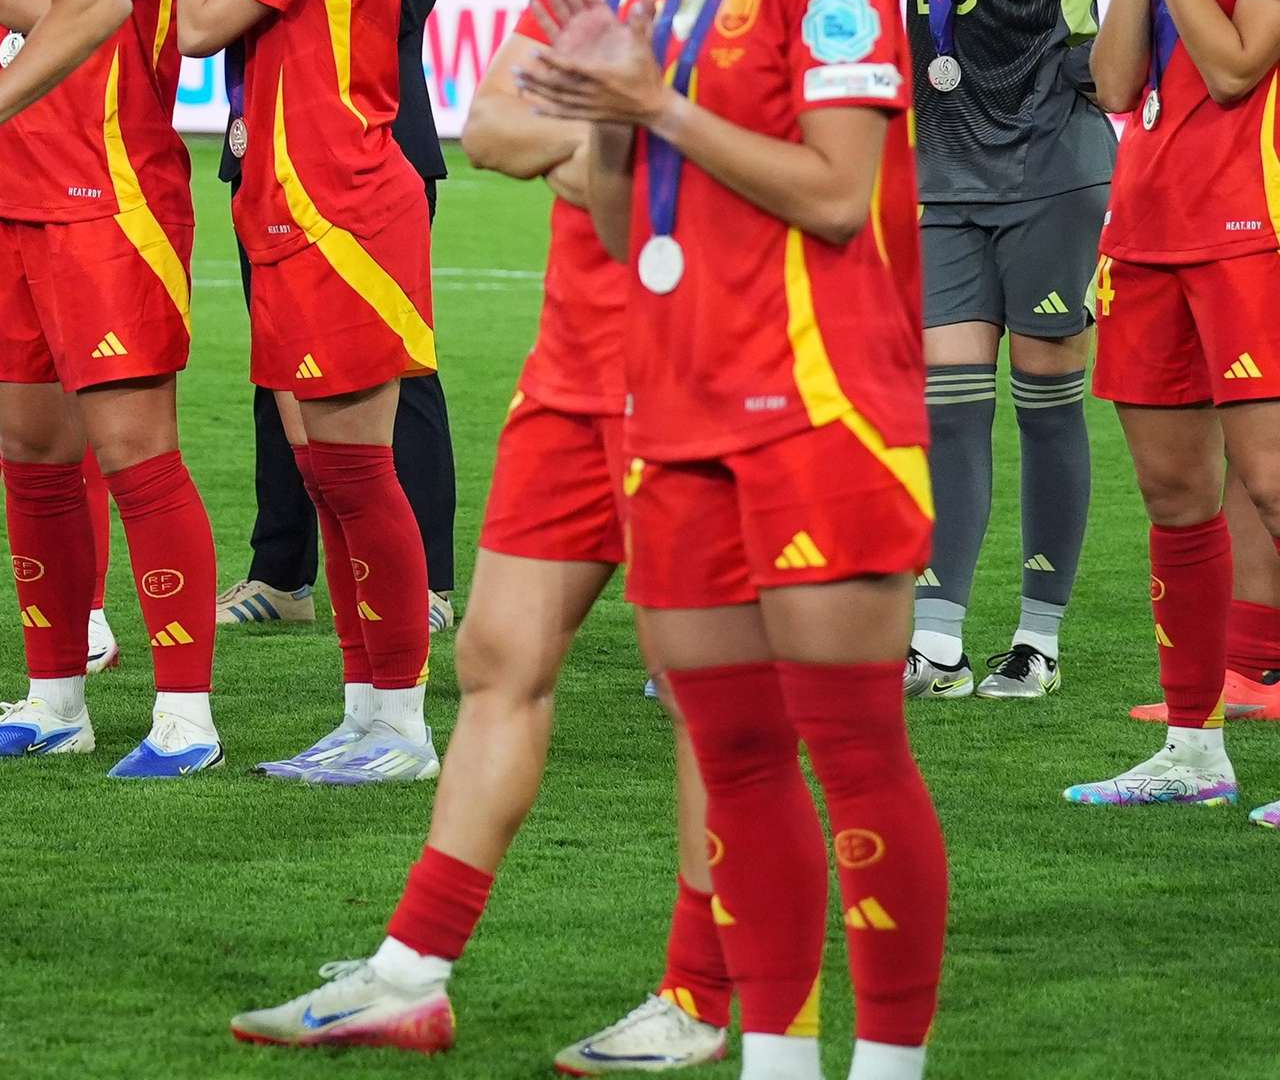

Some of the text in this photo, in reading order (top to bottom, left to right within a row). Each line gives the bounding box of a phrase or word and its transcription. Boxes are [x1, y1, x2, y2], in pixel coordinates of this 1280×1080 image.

[68, 186, 103, 199] HEAT.RDY
[1225, 221, 1262, 231] HEAT.RDY
[149, 575, 172, 584] RF
[150, 583, 173, 592] EF
